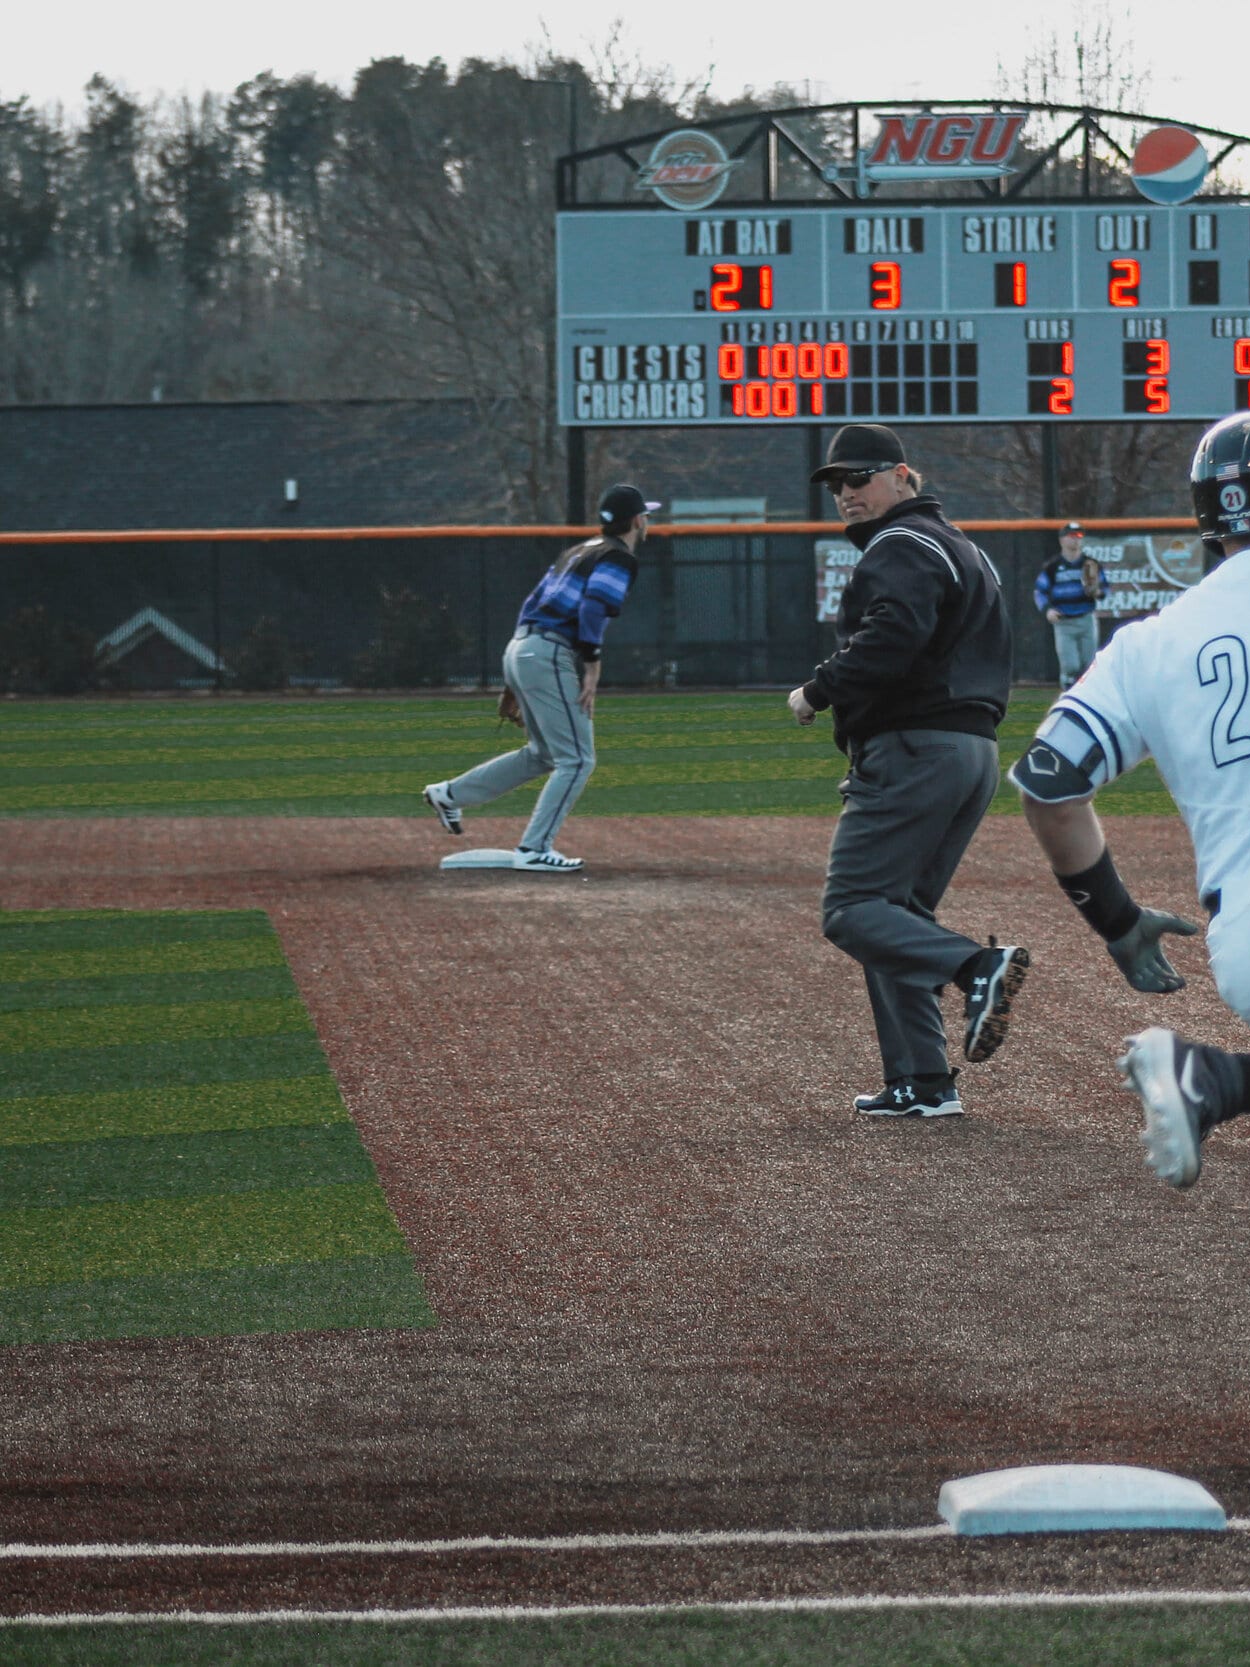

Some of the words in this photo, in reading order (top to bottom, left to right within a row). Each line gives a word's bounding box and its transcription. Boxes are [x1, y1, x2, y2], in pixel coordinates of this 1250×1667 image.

[872, 112, 1025, 163] NGU
[698, 219, 724, 255] AT
[736, 219, 780, 255] BAT
[854, 218, 914, 254] BALL
[964, 216, 1055, 253] STRIKE
[1098, 215, 1149, 251] OUT
[1194, 214, 1213, 250] H
[710, 262, 774, 312] 21
[871, 260, 902, 311] 3
[1012, 261, 1027, 307] 1
[1108, 258, 1141, 307] 2
[726, 323, 735, 342] 1
[750, 323, 762, 342] 2
[776, 323, 789, 342] 3
[802, 322, 814, 342] 4
[829, 322, 841, 341] 5
[856, 322, 867, 341] 6
[882, 321, 893, 341] 7
[908, 321, 919, 340] 8
[934, 321, 945, 340] 9
[1028, 319, 1071, 340] RUNS
[1126, 318, 1164, 339] HITS
[579, 345, 702, 381] GUESTS
[1061, 341, 1075, 376] 1
[1145, 339, 1170, 376] 3
[576, 383, 705, 419] CRUSADERS
[1048, 377, 1075, 414] 2
[1144, 376, 1171, 414] 5
[1224, 491, 1242, 508] 21
